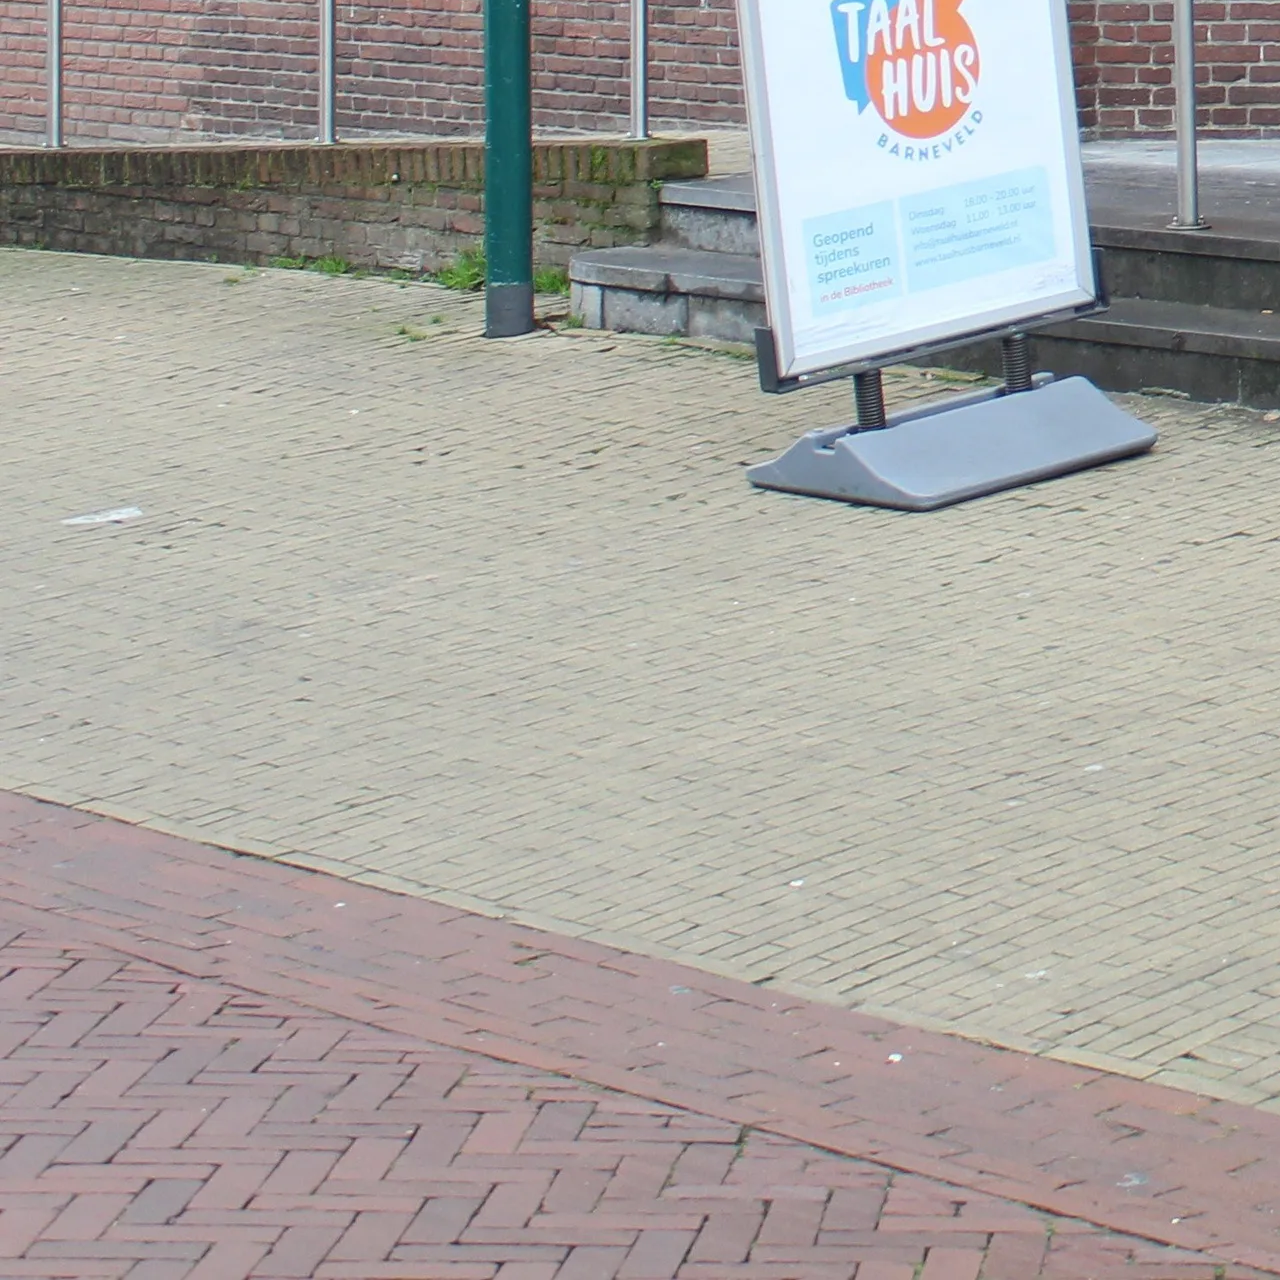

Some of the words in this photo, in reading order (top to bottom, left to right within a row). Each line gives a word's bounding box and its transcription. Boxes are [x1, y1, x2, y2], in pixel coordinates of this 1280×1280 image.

[881, 44, 976, 120] HUIS
[876, 110, 983, 162] BARNEVELD
[813, 222, 874, 247] Geopend
[815, 247, 860, 267] tijdens
[818, 257, 890, 284] spreekuren
[821, 293, 829, 302] in
[831, 291, 842, 300] de
[844, 277, 893, 296] Bibliotheek
